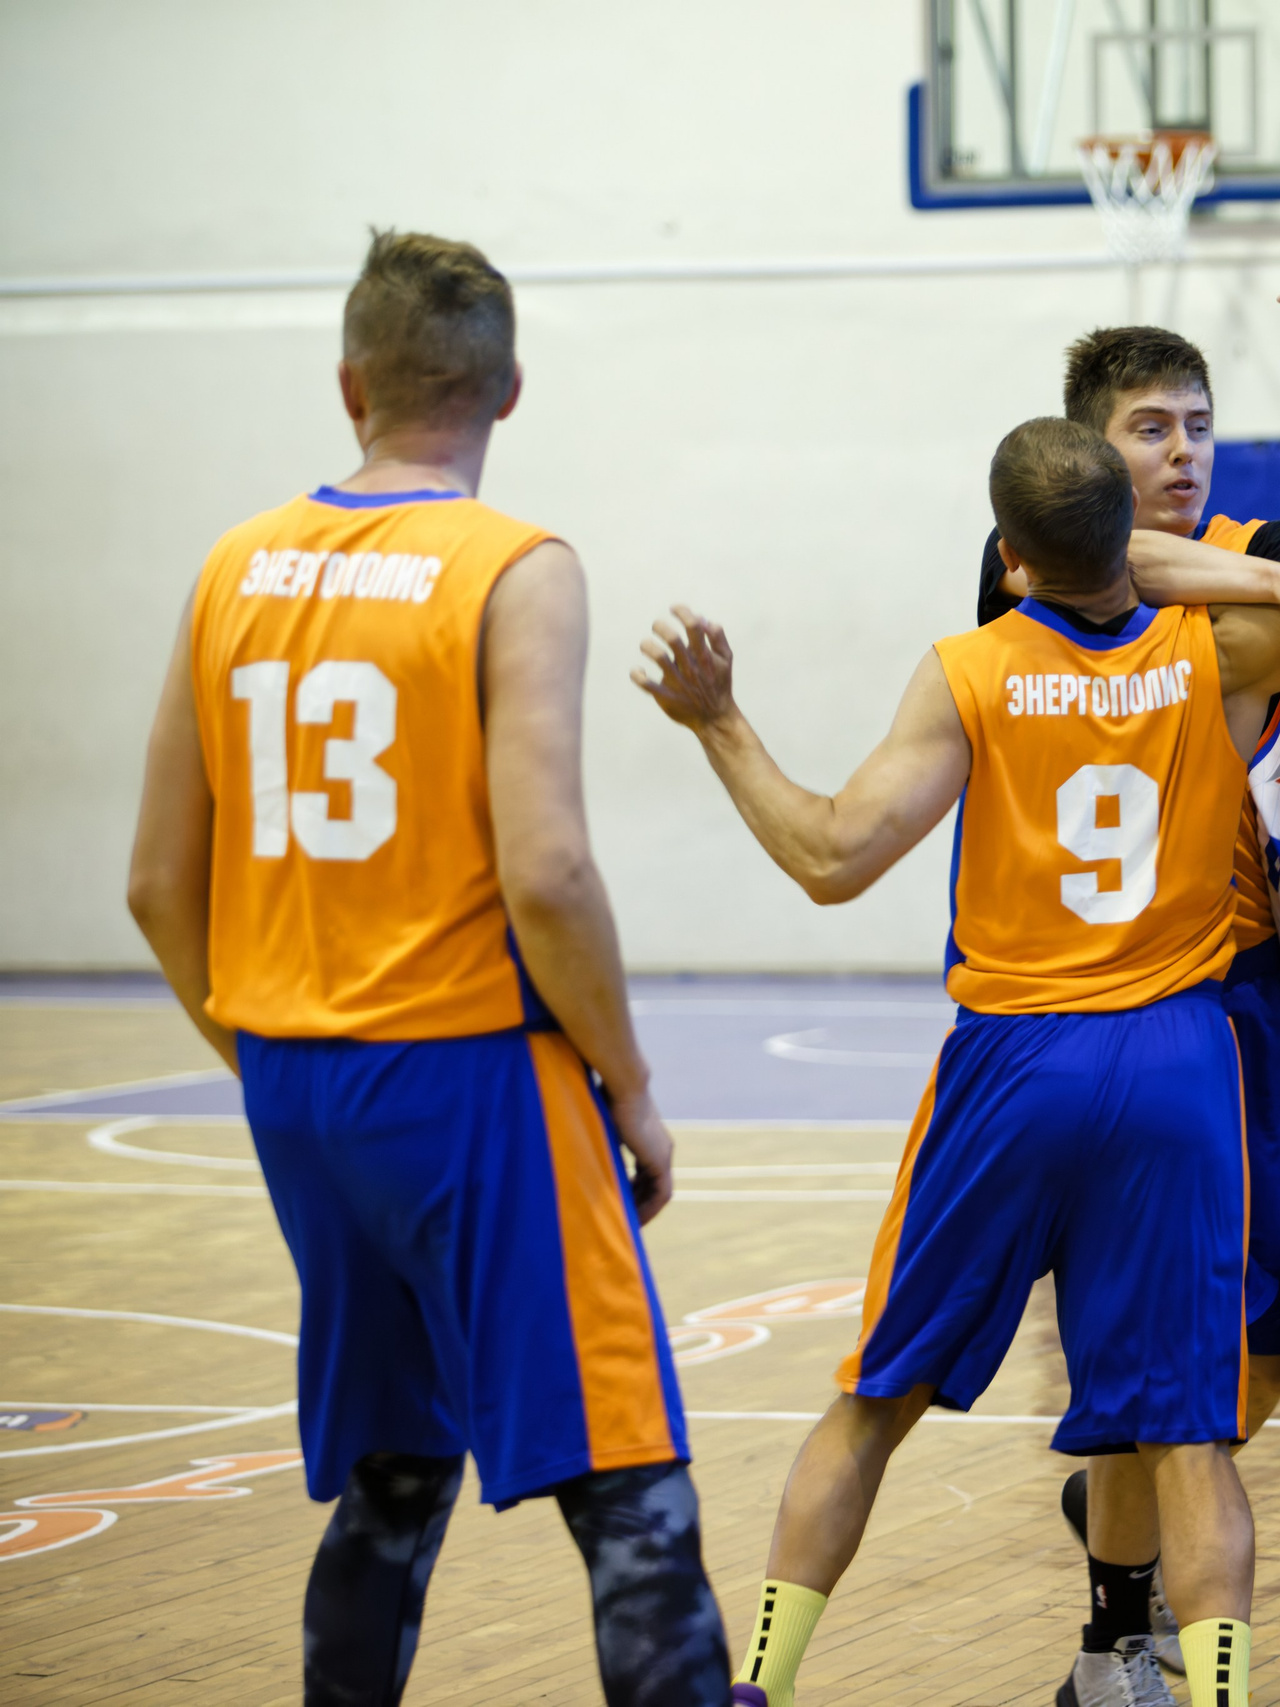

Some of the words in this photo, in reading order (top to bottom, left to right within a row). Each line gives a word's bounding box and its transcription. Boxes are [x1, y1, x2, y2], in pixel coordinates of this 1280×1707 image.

[241, 549, 441, 604] ЭНЕРГОПОЛИС
[1006, 659, 1193, 718] ЭНЕРГОПОЛИС
[231, 661, 397, 861] 13
[1056, 764, 1159, 925] 9
